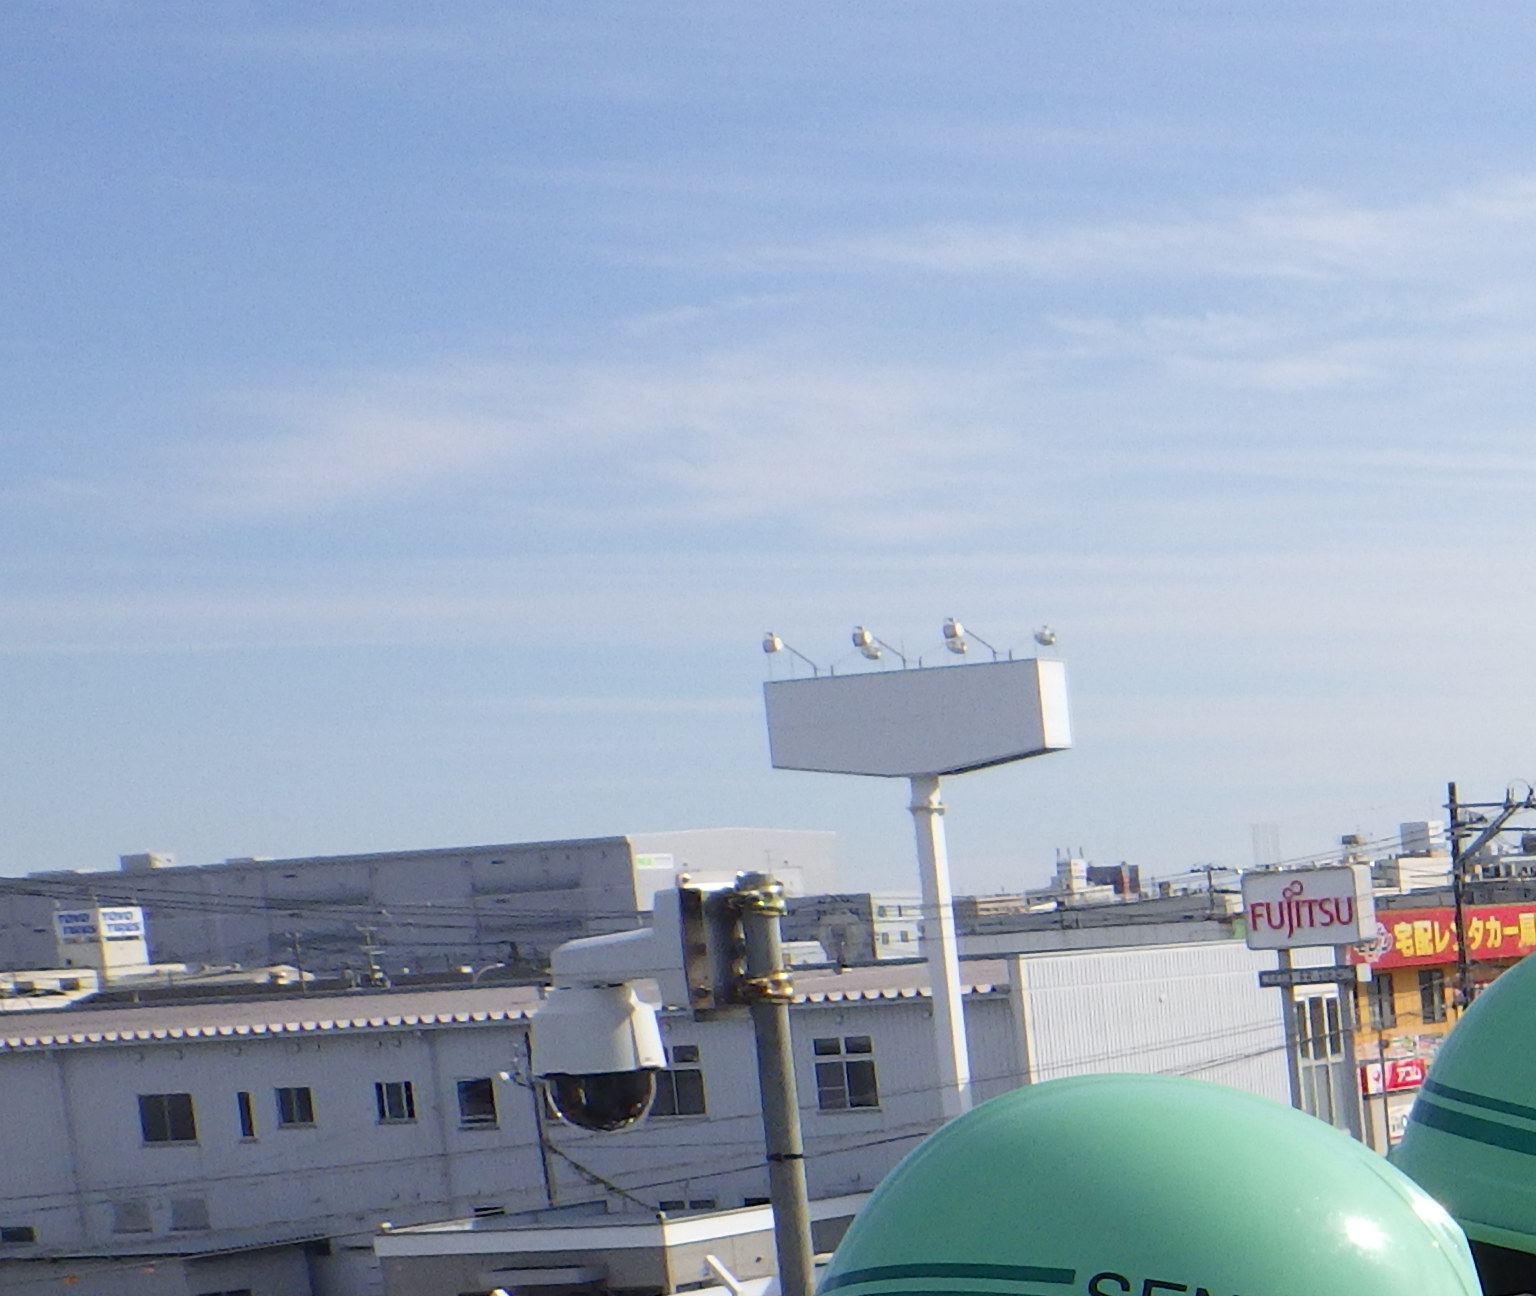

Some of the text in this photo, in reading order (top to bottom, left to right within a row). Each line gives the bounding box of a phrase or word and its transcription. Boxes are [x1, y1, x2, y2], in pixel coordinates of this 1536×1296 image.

[1250, 880, 1354, 938] FUJITSU
[1396, 1064, 1422, 1083] アコム
